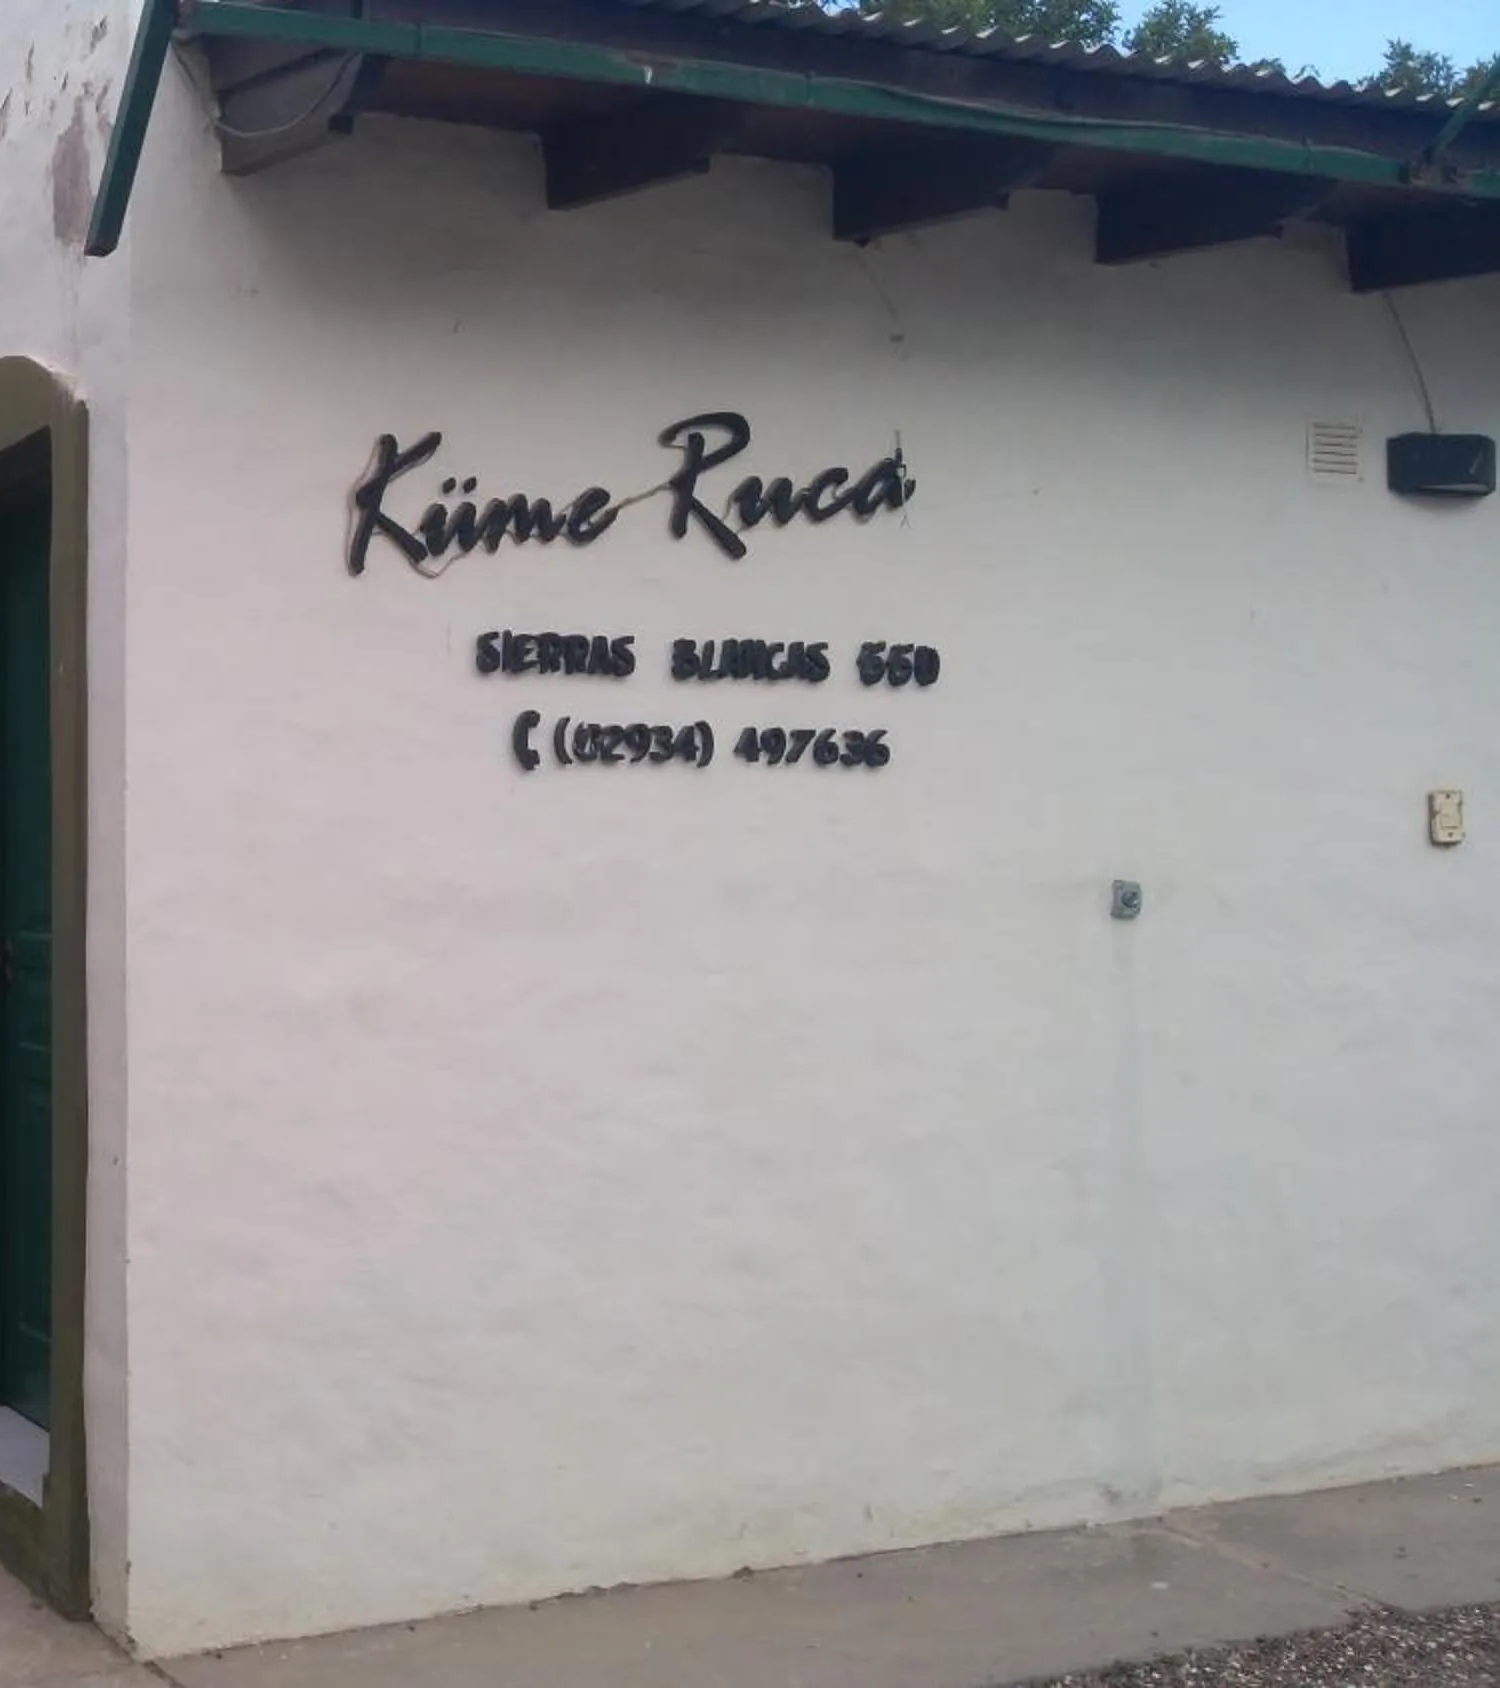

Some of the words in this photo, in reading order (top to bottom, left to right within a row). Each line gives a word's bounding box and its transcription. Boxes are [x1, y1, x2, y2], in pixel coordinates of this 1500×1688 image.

[348, 431, 620, 573] Küme
[476, 629, 636, 677] SIERRAS
[671, 638, 830, 681] BLANCAS
[553, 716, 714, 768] (02934)
[733, 726, 891, 767] 497636
